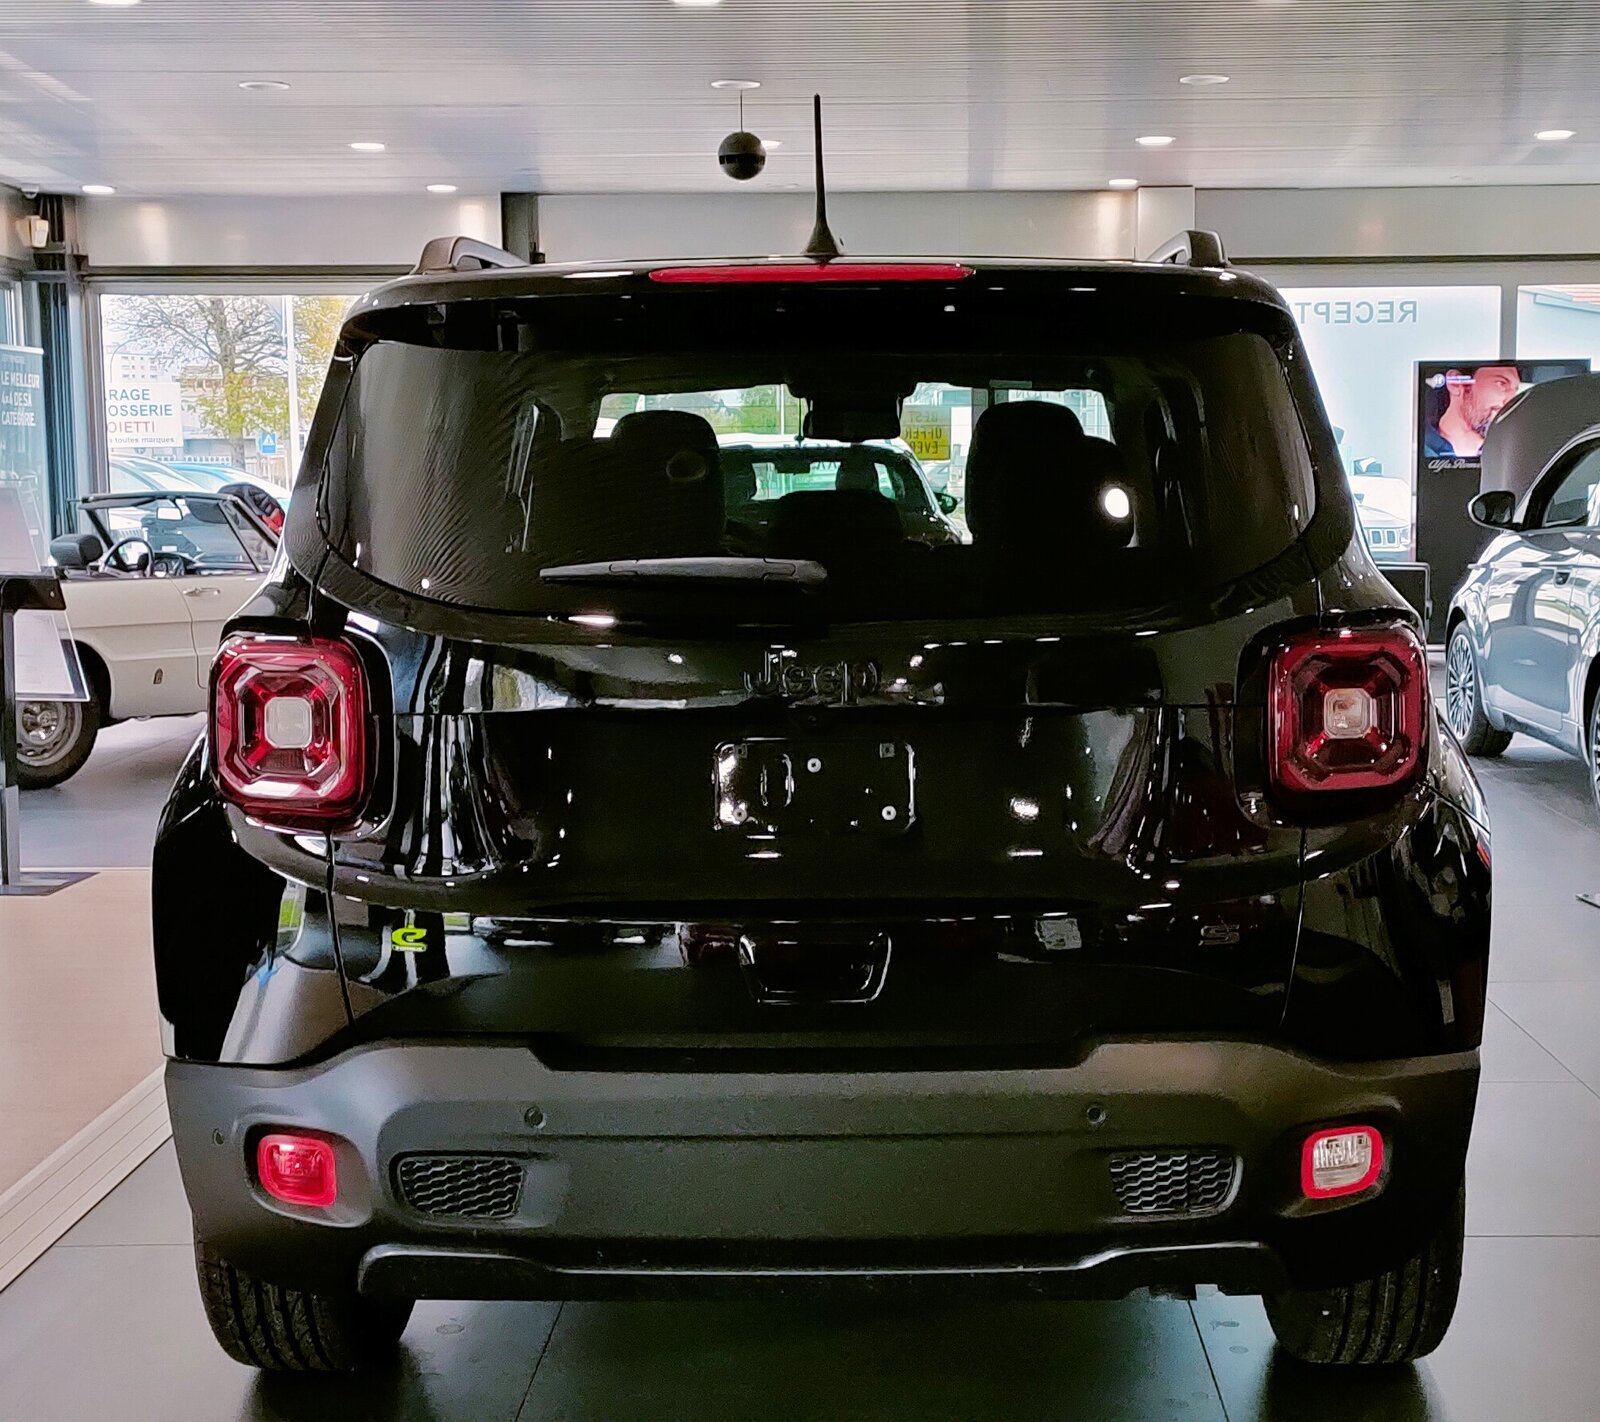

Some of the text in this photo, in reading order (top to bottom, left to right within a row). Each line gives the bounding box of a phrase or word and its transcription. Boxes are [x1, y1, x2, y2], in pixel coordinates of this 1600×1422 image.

[10, 371, 40, 388] MEILLEUR
[108, 388, 151, 401] RAGE
[108, 404, 174, 417] OSSERIE
[115, 436, 139, 444] toutes
[141, 437, 175, 445] marques
[743, 650, 878, 706] Jeep
